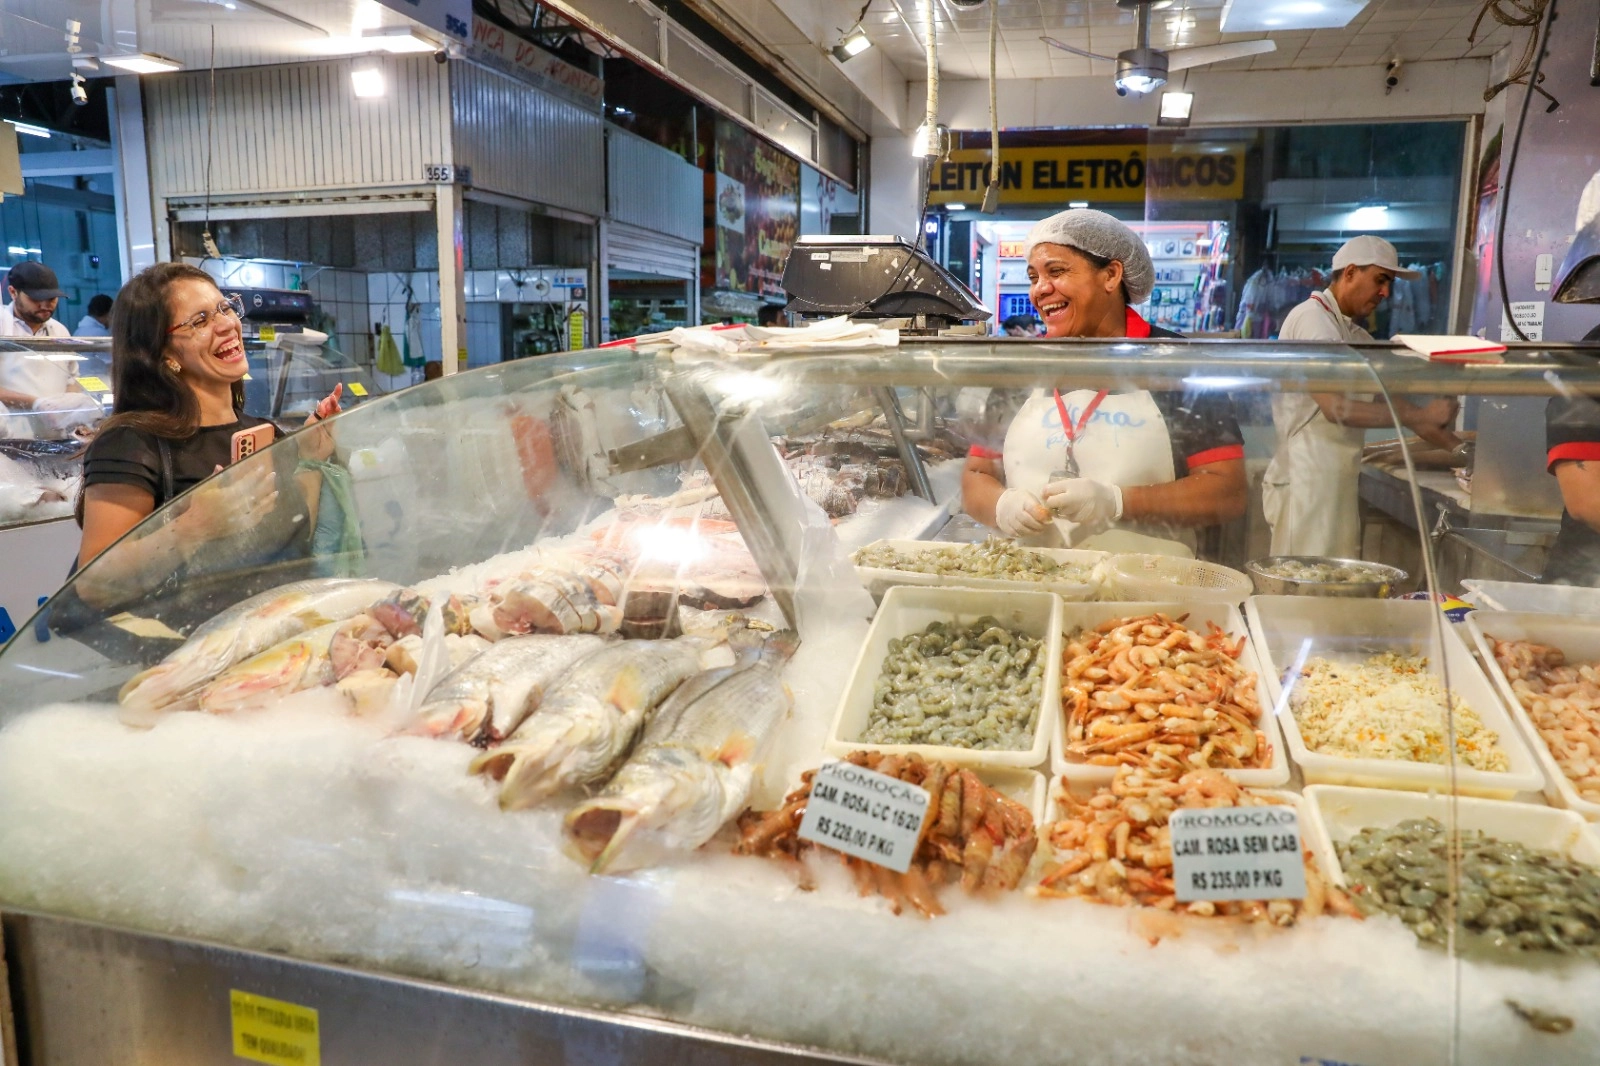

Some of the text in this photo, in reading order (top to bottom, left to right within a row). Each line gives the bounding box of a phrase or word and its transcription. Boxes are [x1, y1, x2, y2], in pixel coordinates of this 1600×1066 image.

[427, 167, 449, 181] 355
[1032, 151, 1236, 190] ELETRÔNICOS
[840, 791, 870, 815] ROSA
[1207, 837, 1240, 854] ROSA
[1243, 835, 1268, 853] SEM
[1271, 834, 1298, 852] CAB
